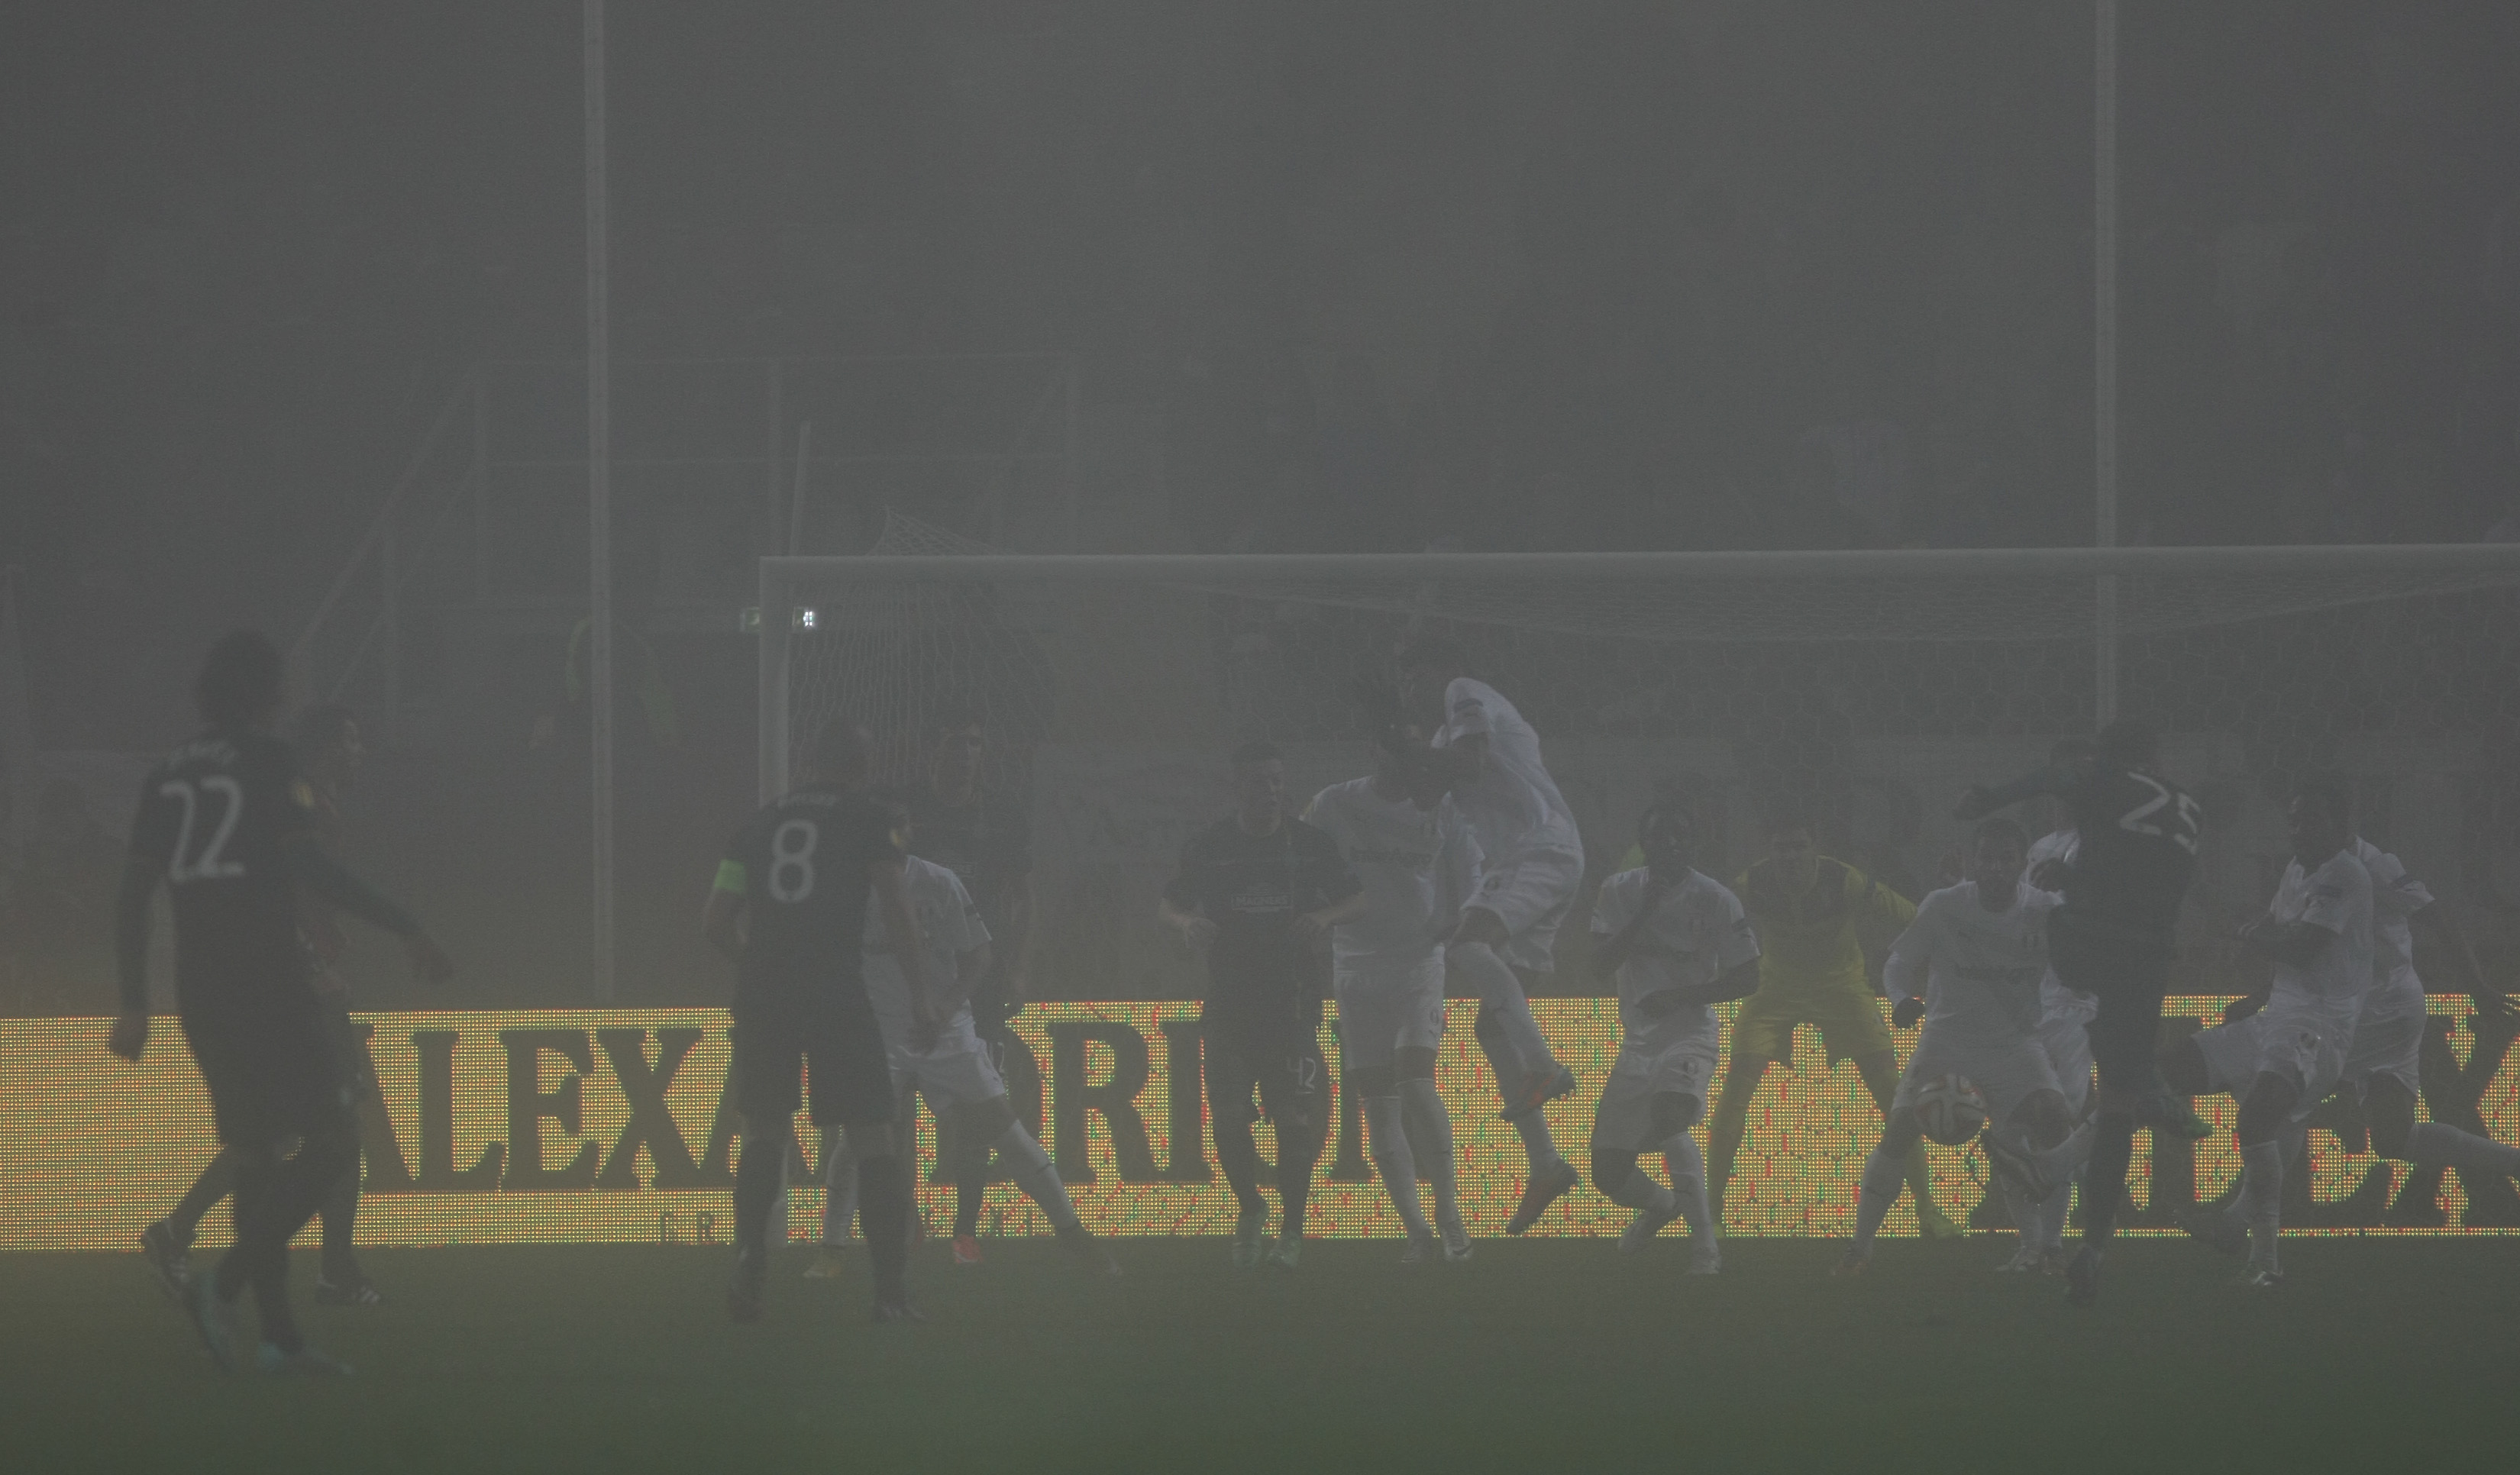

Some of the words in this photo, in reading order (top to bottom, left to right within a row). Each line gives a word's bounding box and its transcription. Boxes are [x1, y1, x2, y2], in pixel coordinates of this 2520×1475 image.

[160, 775, 245, 884] 22
[2119, 771, 2202, 855] 25
[769, 818, 819, 903] 8
[1286, 1056, 1318, 1090] 42
